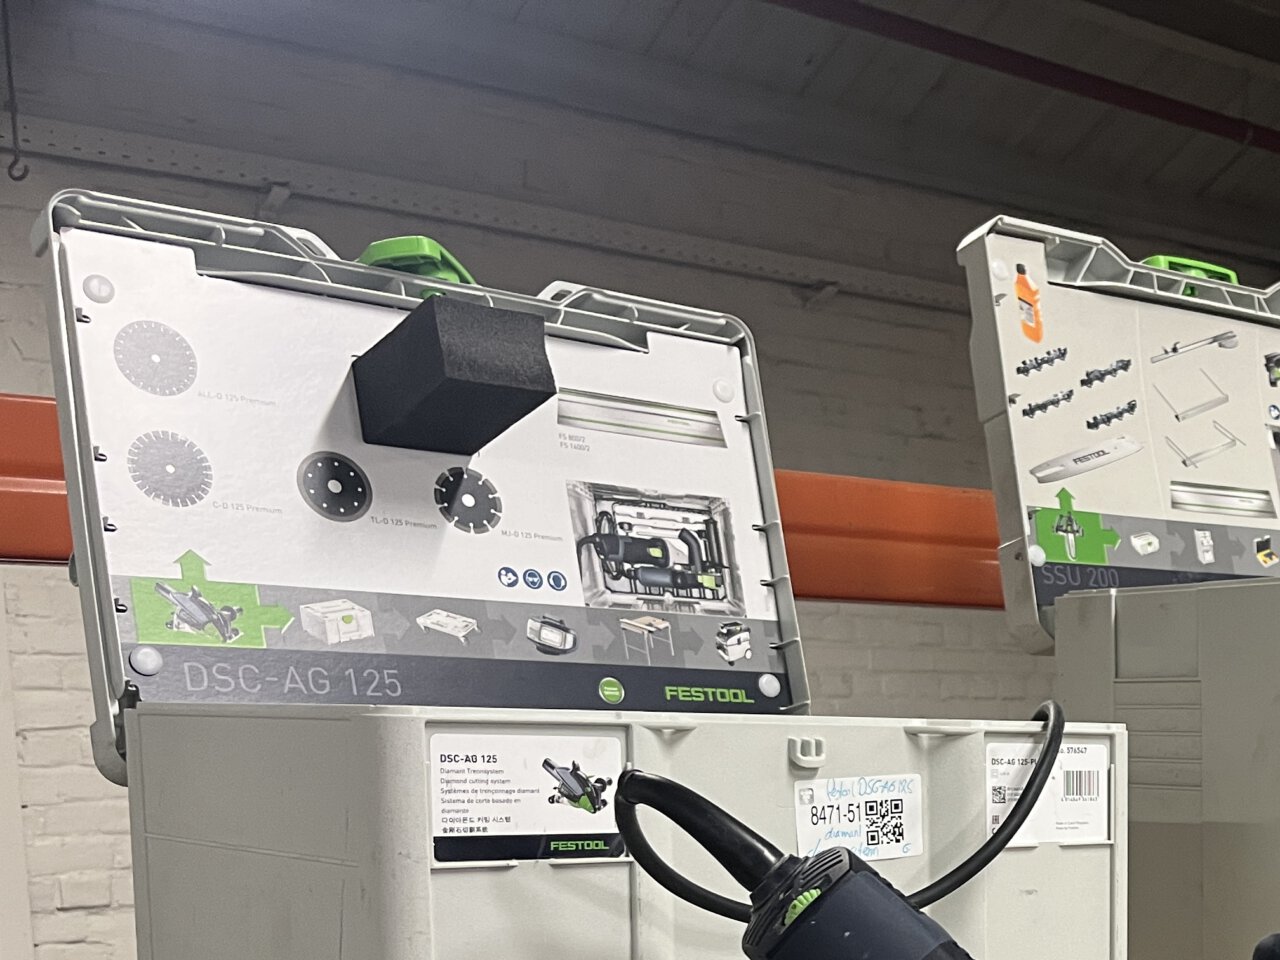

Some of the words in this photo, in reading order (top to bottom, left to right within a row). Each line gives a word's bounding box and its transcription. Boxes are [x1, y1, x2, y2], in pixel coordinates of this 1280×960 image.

[390, 518, 403, 526] 125
[404, 519, 437, 530] Premium
[1041, 565, 1081, 585] SSU
[1086, 567, 1120, 588] 200
[183, 661, 331, 695] DSC-AG
[344, 668, 402, 697] 125
[665, 686, 755, 704] FESTOOL
[439, 754, 478, 763] DSC-AG
[481, 754, 498, 763] 125
[991, 758, 1016, 766] DSC-AG
[811, 803, 861, 826] 8471-51
[550, 840, 609, 851] FESTOOL
